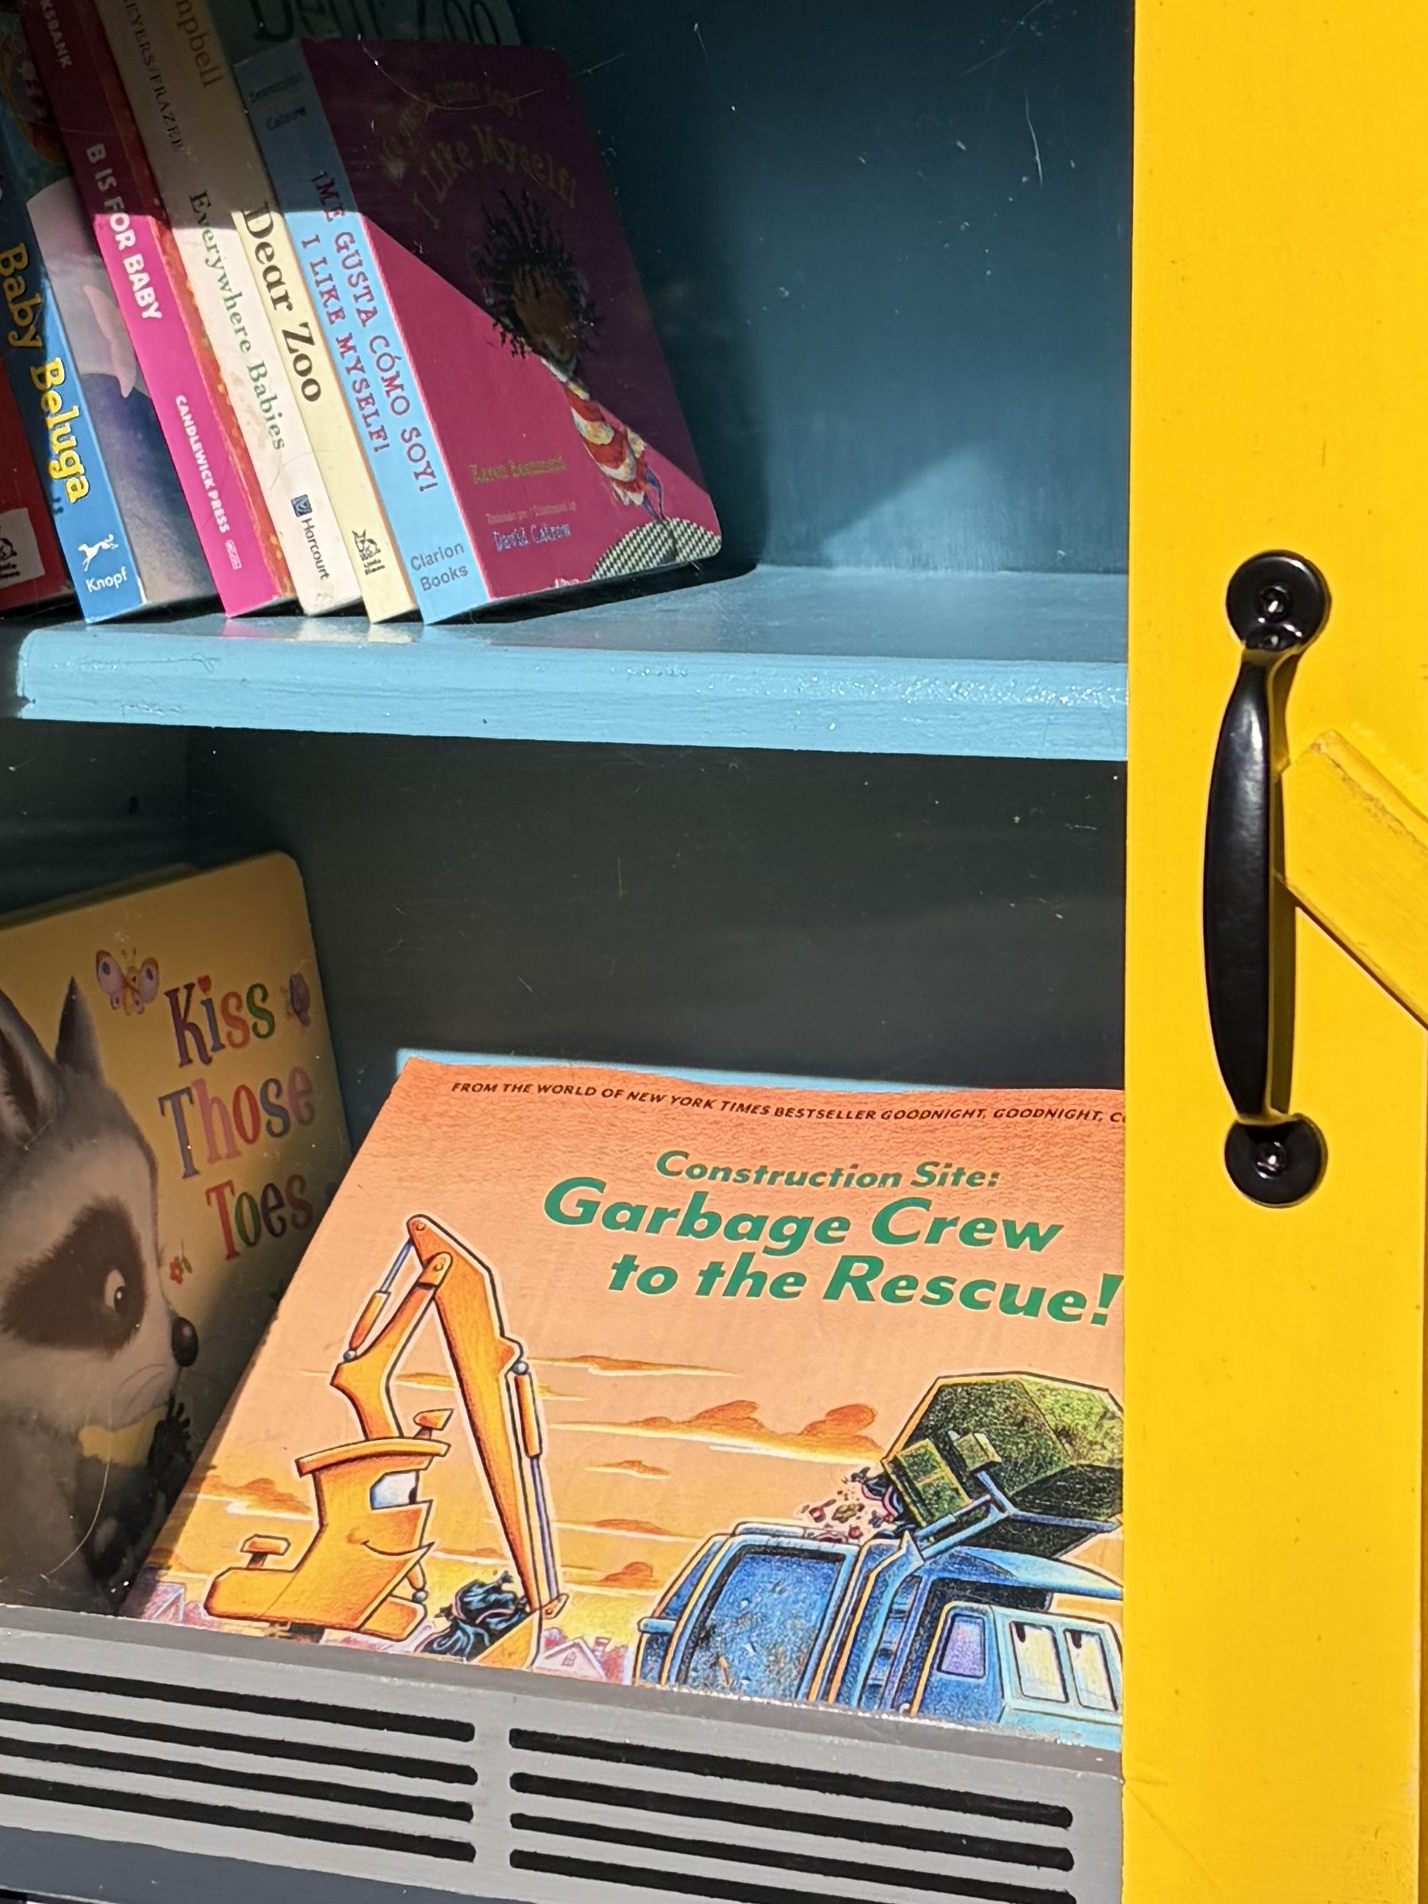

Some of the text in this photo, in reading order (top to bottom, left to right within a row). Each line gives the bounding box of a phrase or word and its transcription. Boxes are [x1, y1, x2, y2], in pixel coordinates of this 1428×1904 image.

[86, 143, 163, 322] B IS FOR BABY
[188, 191, 286, 451] Everywhere Babies
[238, 200, 322, 404] Dear Zoo
[301, 233, 391, 454] I LIKE MYSELF!
[333, 230, 379, 329] GUSTA
[368, 334, 411, 418] CÓMO
[400, 425, 439, 493] SOY!
[29, 356, 92, 506] Beluga
[174, 394, 231, 535] CANDLEWICK PRESS
[85, 566, 128, 594] Knopf
[300, 516, 330, 582] Harcourt
[410, 542, 466, 572] Clarion
[419, 561, 469, 592] Books
[163, 974, 276, 1069] Kiss
[157, 1065, 316, 1181] Those
[450, 1081, 499, 1094] FROM
[502, 1082, 534, 1094] THE
[536, 1083, 597, 1097] WORLD
[600, 1087, 624, 1099] OF
[625, 1090, 670, 1104] NEW
[670, 1094, 718, 1110] YORK
[720, 1099, 772, 1117] TIMES
[773, 1105, 877, 1121] BESTSELLER
[879, 1107, 987, 1122] GOODNIGHT,
[992, 1107, 1104, 1124] GOODNIGHT,
[654, 1148, 1003, 1190] Construction Site:
[204, 1174, 314, 1261] Toes
[542, 1175, 1066, 1258] Garbage Crew
[606, 1250, 1125, 1328] to the Rescue!
